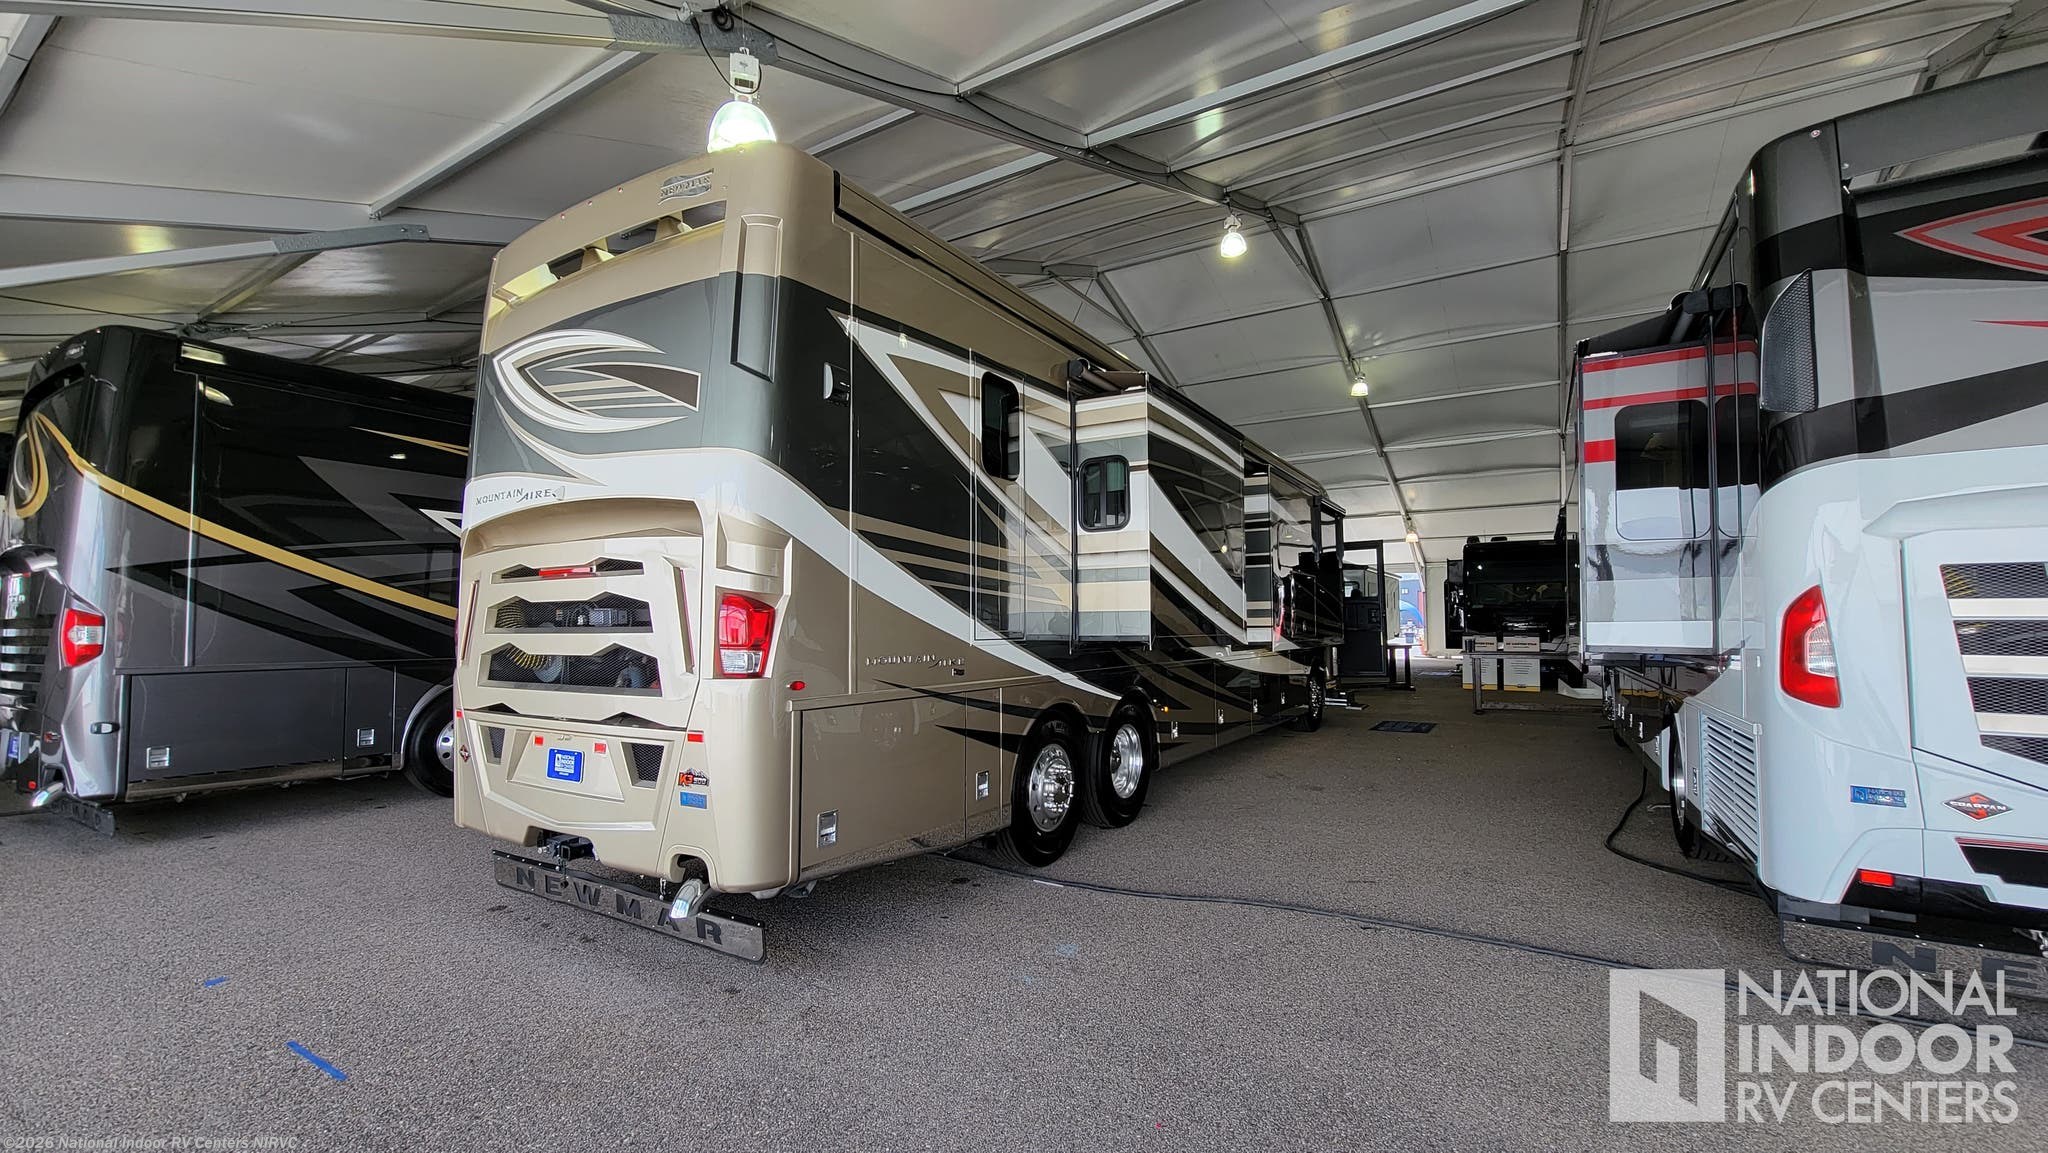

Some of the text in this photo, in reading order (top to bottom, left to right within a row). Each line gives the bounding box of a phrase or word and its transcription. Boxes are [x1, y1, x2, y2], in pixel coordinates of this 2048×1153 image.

[476, 488, 552, 505] MOUNTAIN AIRE
[866, 654, 936, 666] MOUNTAIN
[1949, 801, 2007, 811] SPARTAN
[516, 866, 722, 945] NEWMAR
